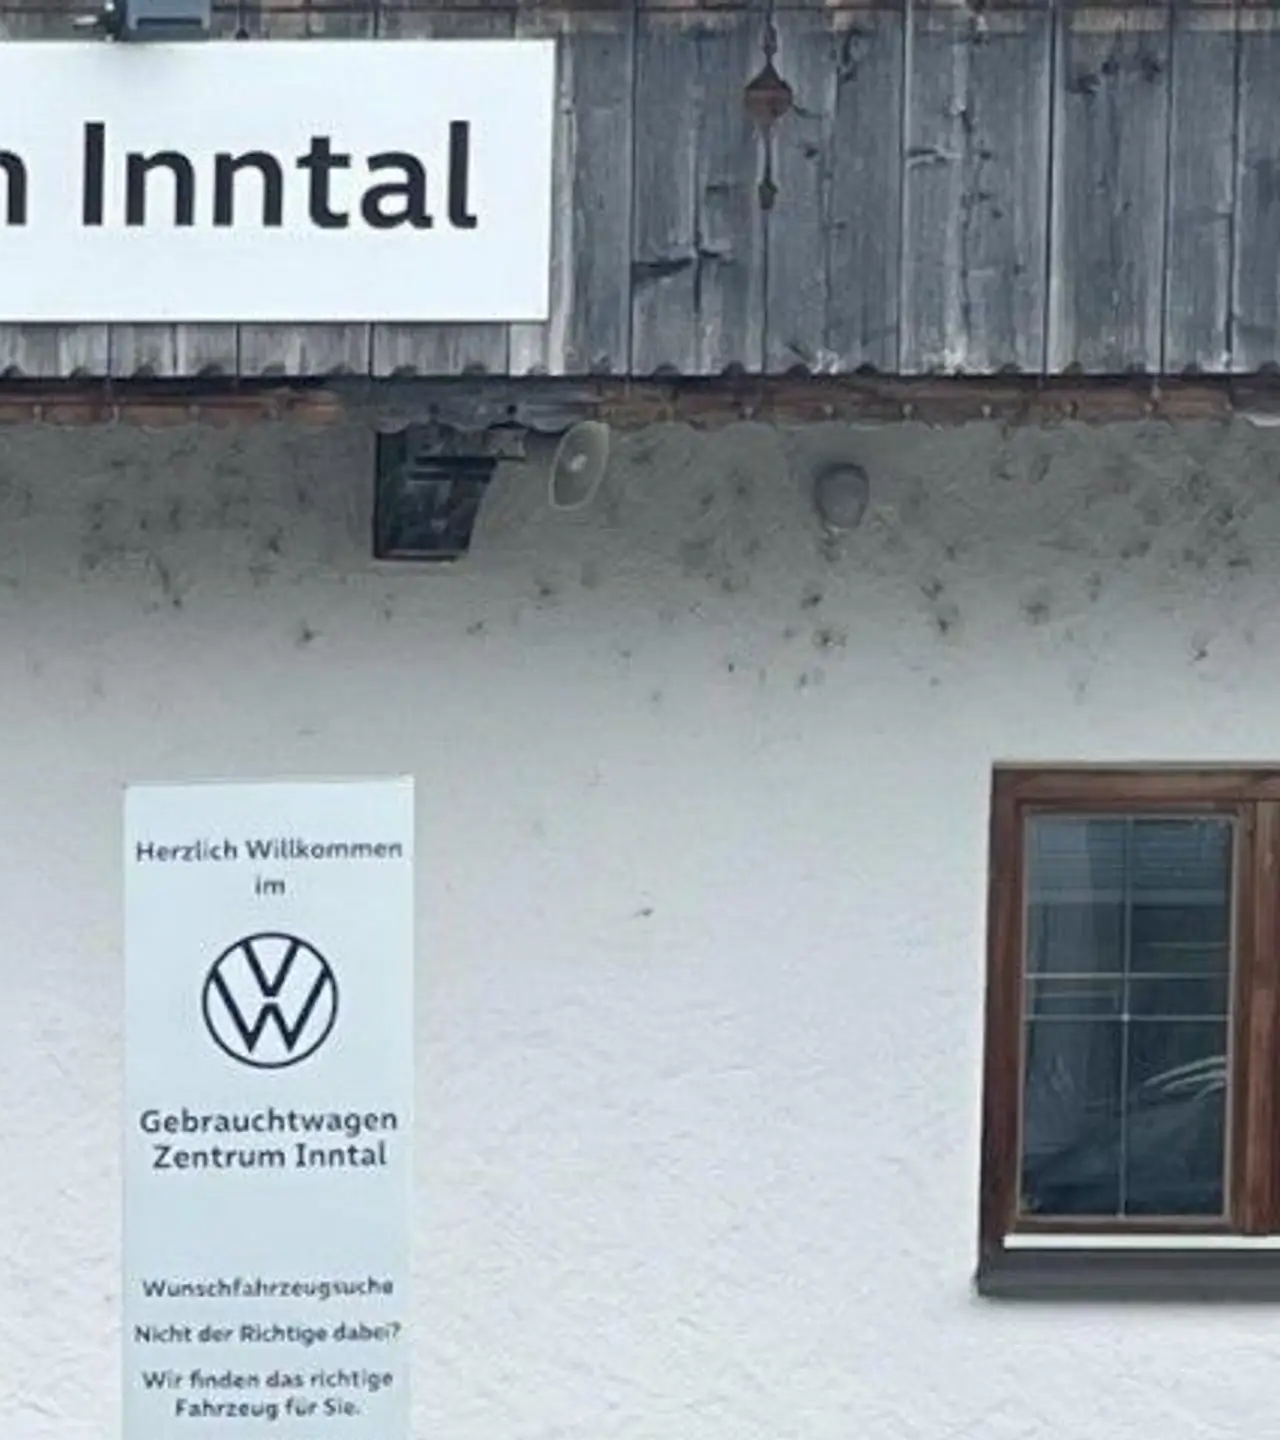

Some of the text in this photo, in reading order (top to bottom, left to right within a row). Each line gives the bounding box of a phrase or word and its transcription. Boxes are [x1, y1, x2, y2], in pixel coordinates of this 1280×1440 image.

[82, 119, 478, 230] Inntal
[135, 837, 403, 862] Herzlich Willkommen
[254, 876, 286, 896] im
[139, 1106, 398, 1138] Gebrauchtwagen
[152, 1139, 387, 1170] Zentrum Inntal
[142, 1275, 394, 1302] Wunschfahrzeugsuche
[134, 1321, 402, 1348] Nicht der Richtige dabei?
[141, 1368, 394, 1393] Wir finden das richtige
[175, 1396, 361, 1422] Fahrzeug für Sie.
